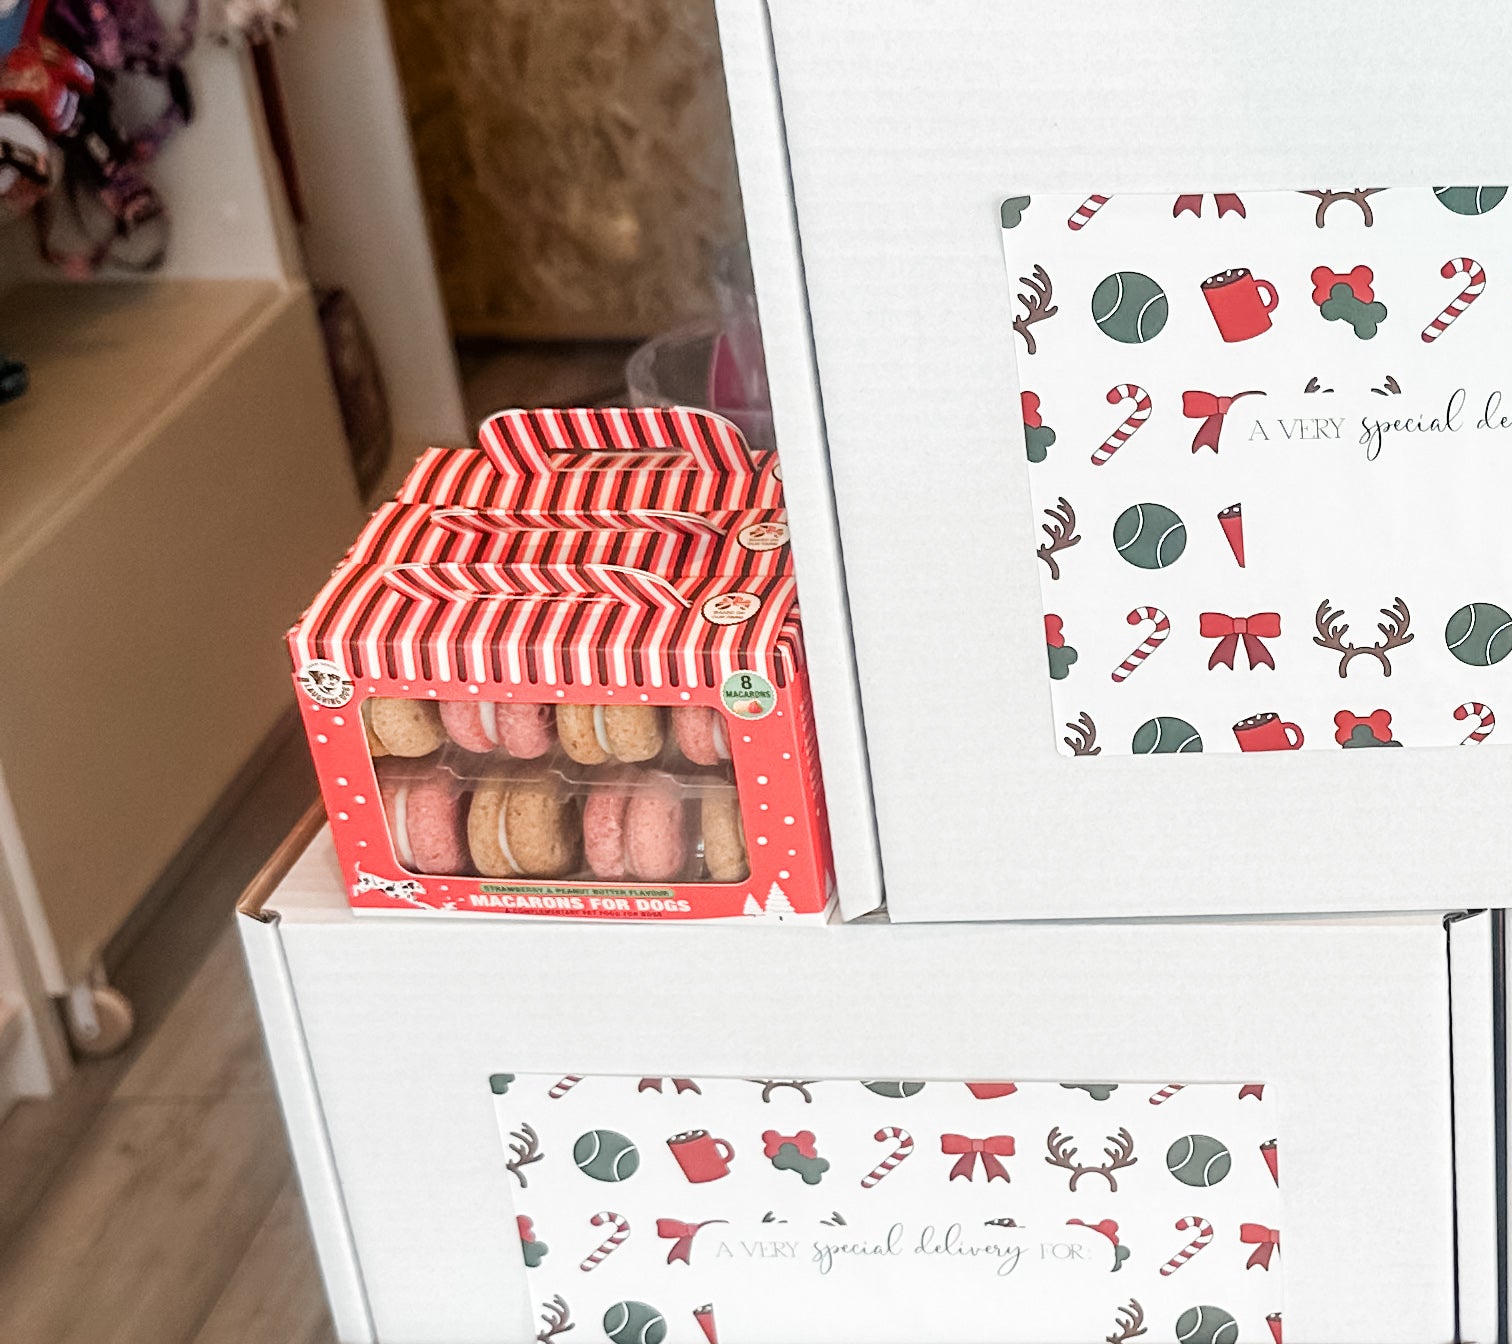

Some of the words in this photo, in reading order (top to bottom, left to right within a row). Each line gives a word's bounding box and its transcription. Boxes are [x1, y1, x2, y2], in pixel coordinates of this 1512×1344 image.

[1248, 418, 1270, 442] A
[1277, 416, 1345, 440] VERY
[1359, 388, 1467, 461] special
[740, 675, 752, 690] 8
[726, 690, 771, 699] MACARONS
[469, 894, 585, 910] MACARONS
[590, 898, 631, 911] FOR
[636, 899, 692, 913] DOGS
[740, 1240, 800, 1258] VERY
[811, 1223, 906, 1274] special
[914, 1223, 1028, 1276] delivery
